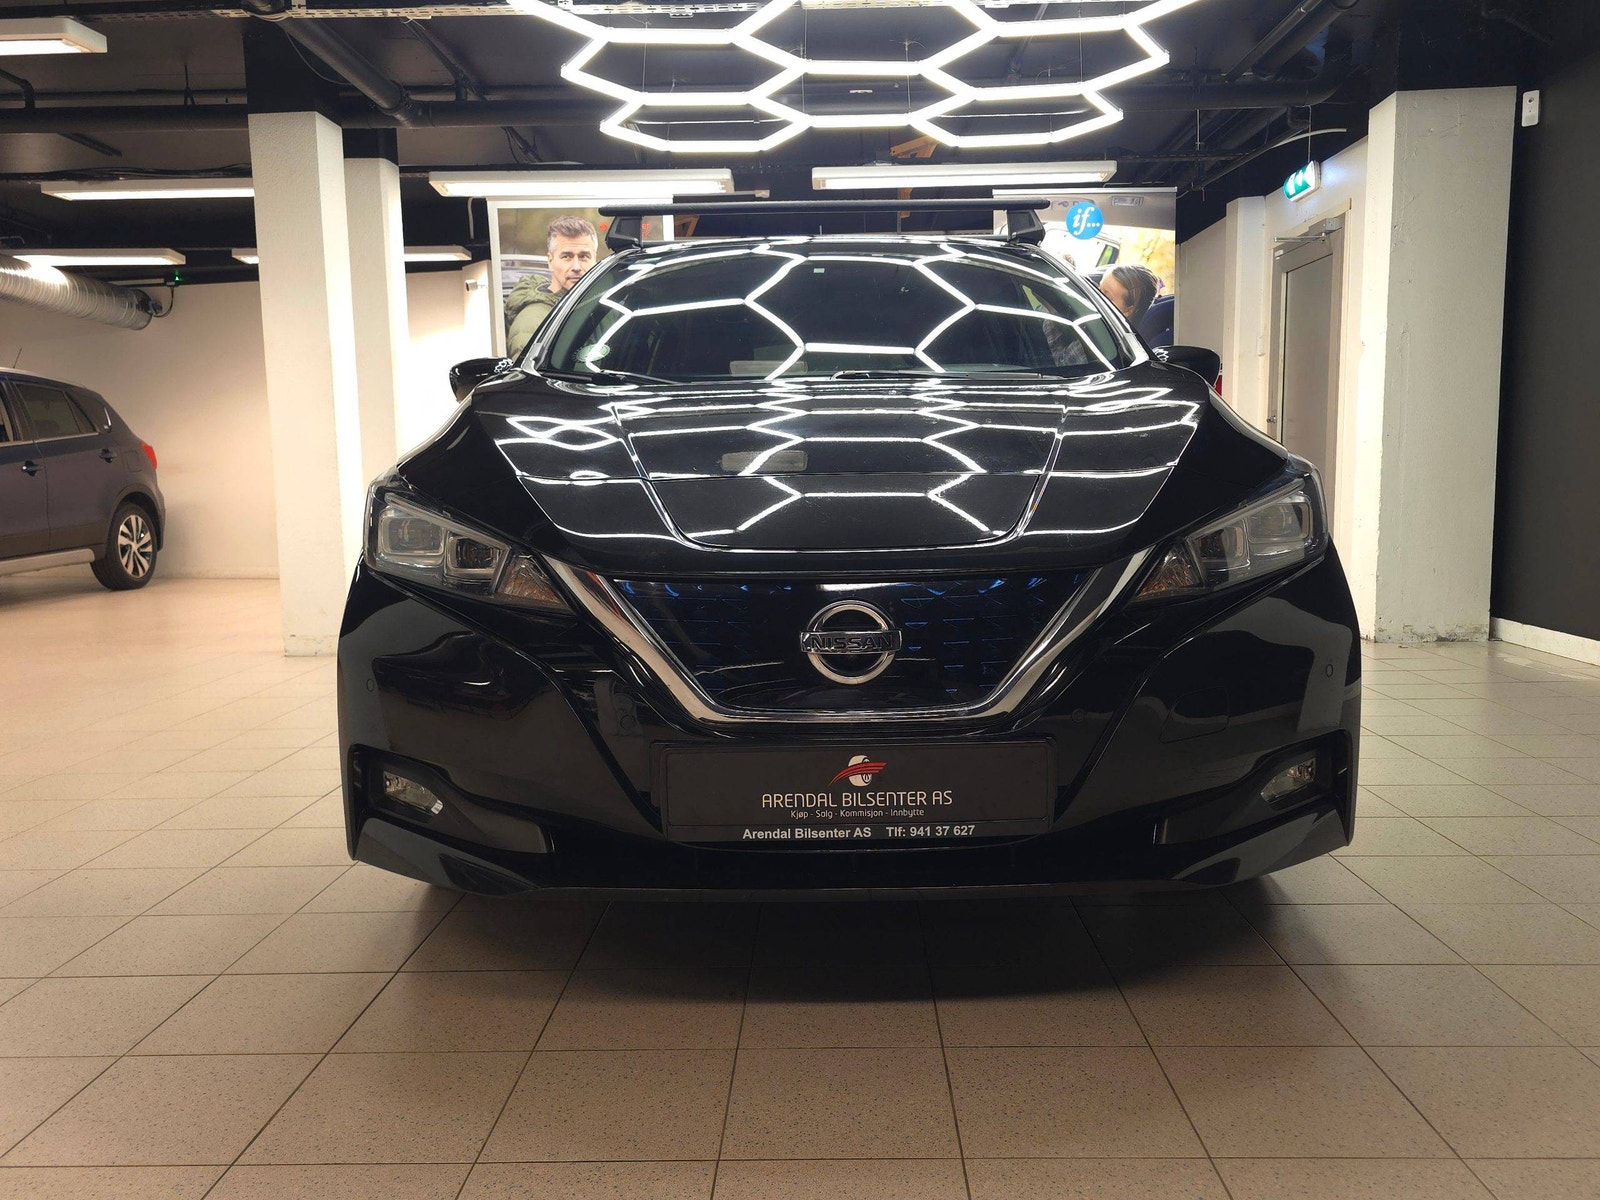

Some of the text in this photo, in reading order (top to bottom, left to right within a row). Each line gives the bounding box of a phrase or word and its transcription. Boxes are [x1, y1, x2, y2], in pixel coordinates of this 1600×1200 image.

[811, 634, 894, 651] NISSAN
[762, 790, 953, 808] ARENDAL BILSENTER AS
[790, 810, 809, 820] Kjøp
[815, 809, 833, 819] Salg
[840, 808, 884, 819] Kommisjon
[890, 808, 925, 818] Innbytte
[742, 825, 976, 840] Arendal Bilsenter AS Tlf: 941 37 627
